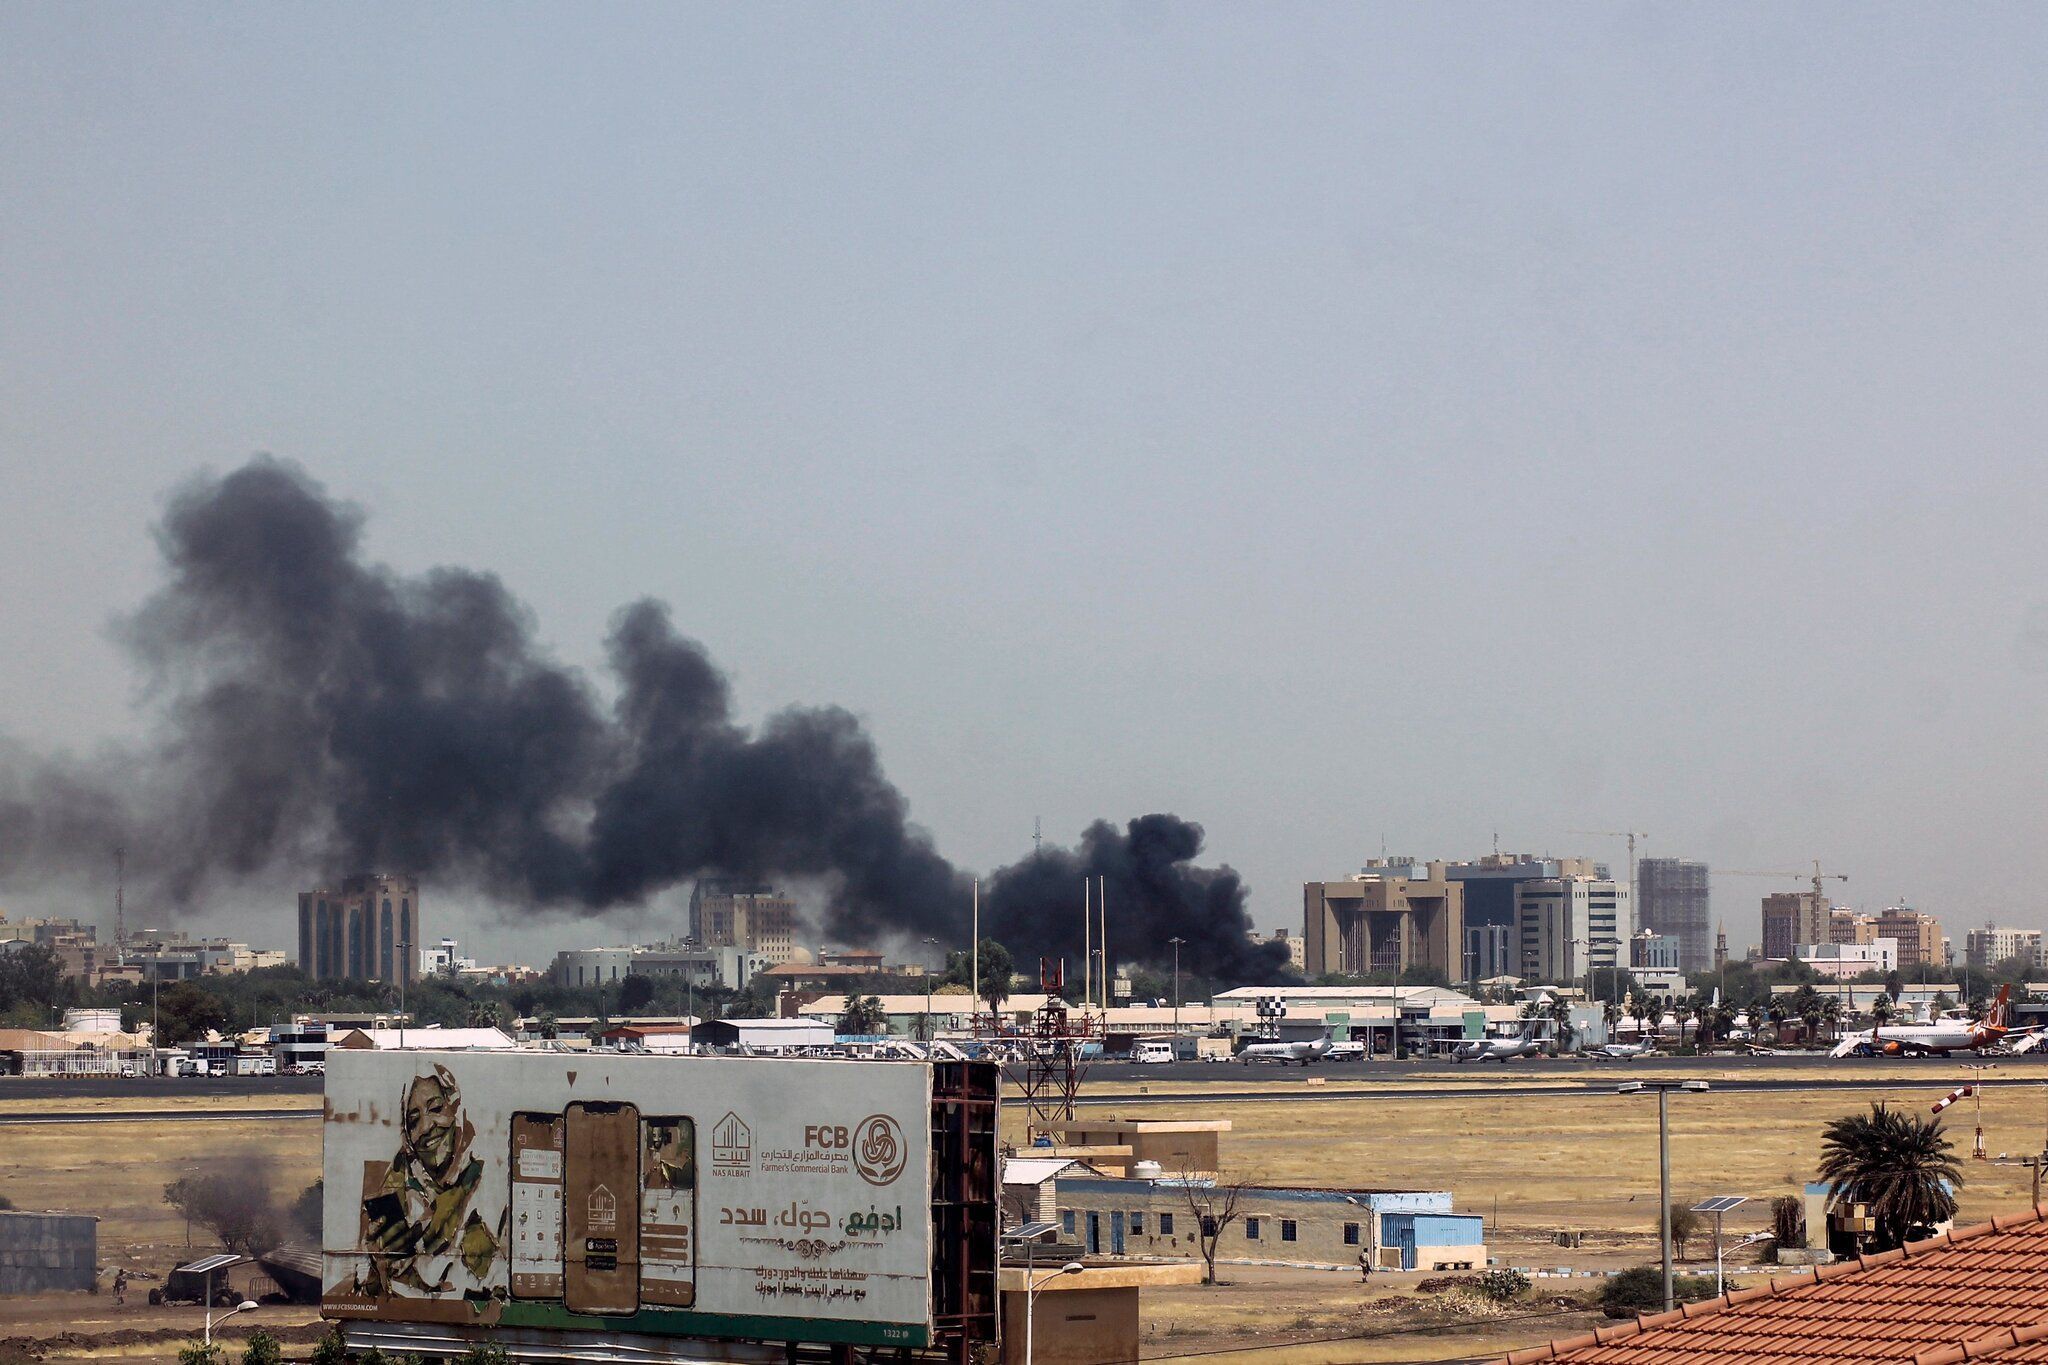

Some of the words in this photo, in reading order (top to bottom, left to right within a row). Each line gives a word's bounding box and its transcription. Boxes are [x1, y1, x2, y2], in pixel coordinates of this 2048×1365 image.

[804, 1125, 849, 1149] FCB
[761, 1149, 792, 1162] التجاري
[792, 1150, 820, 1162] المزارع
[820, 1150, 849, 1163] مصرف
[712, 1169, 726, 1177] NAS
[727, 1169, 751, 1178] ALBAIT
[761, 1163, 790, 1172] Farmer's
[790, 1163, 830, 1173] Commercial
[831, 1164, 849, 1174] Bank
[719, 1207, 767, 1226] سدد
[323, 1303, 378, 1311] WWW.FCBSUDAN.COM
[883, 1329, 901, 1338] 1322
